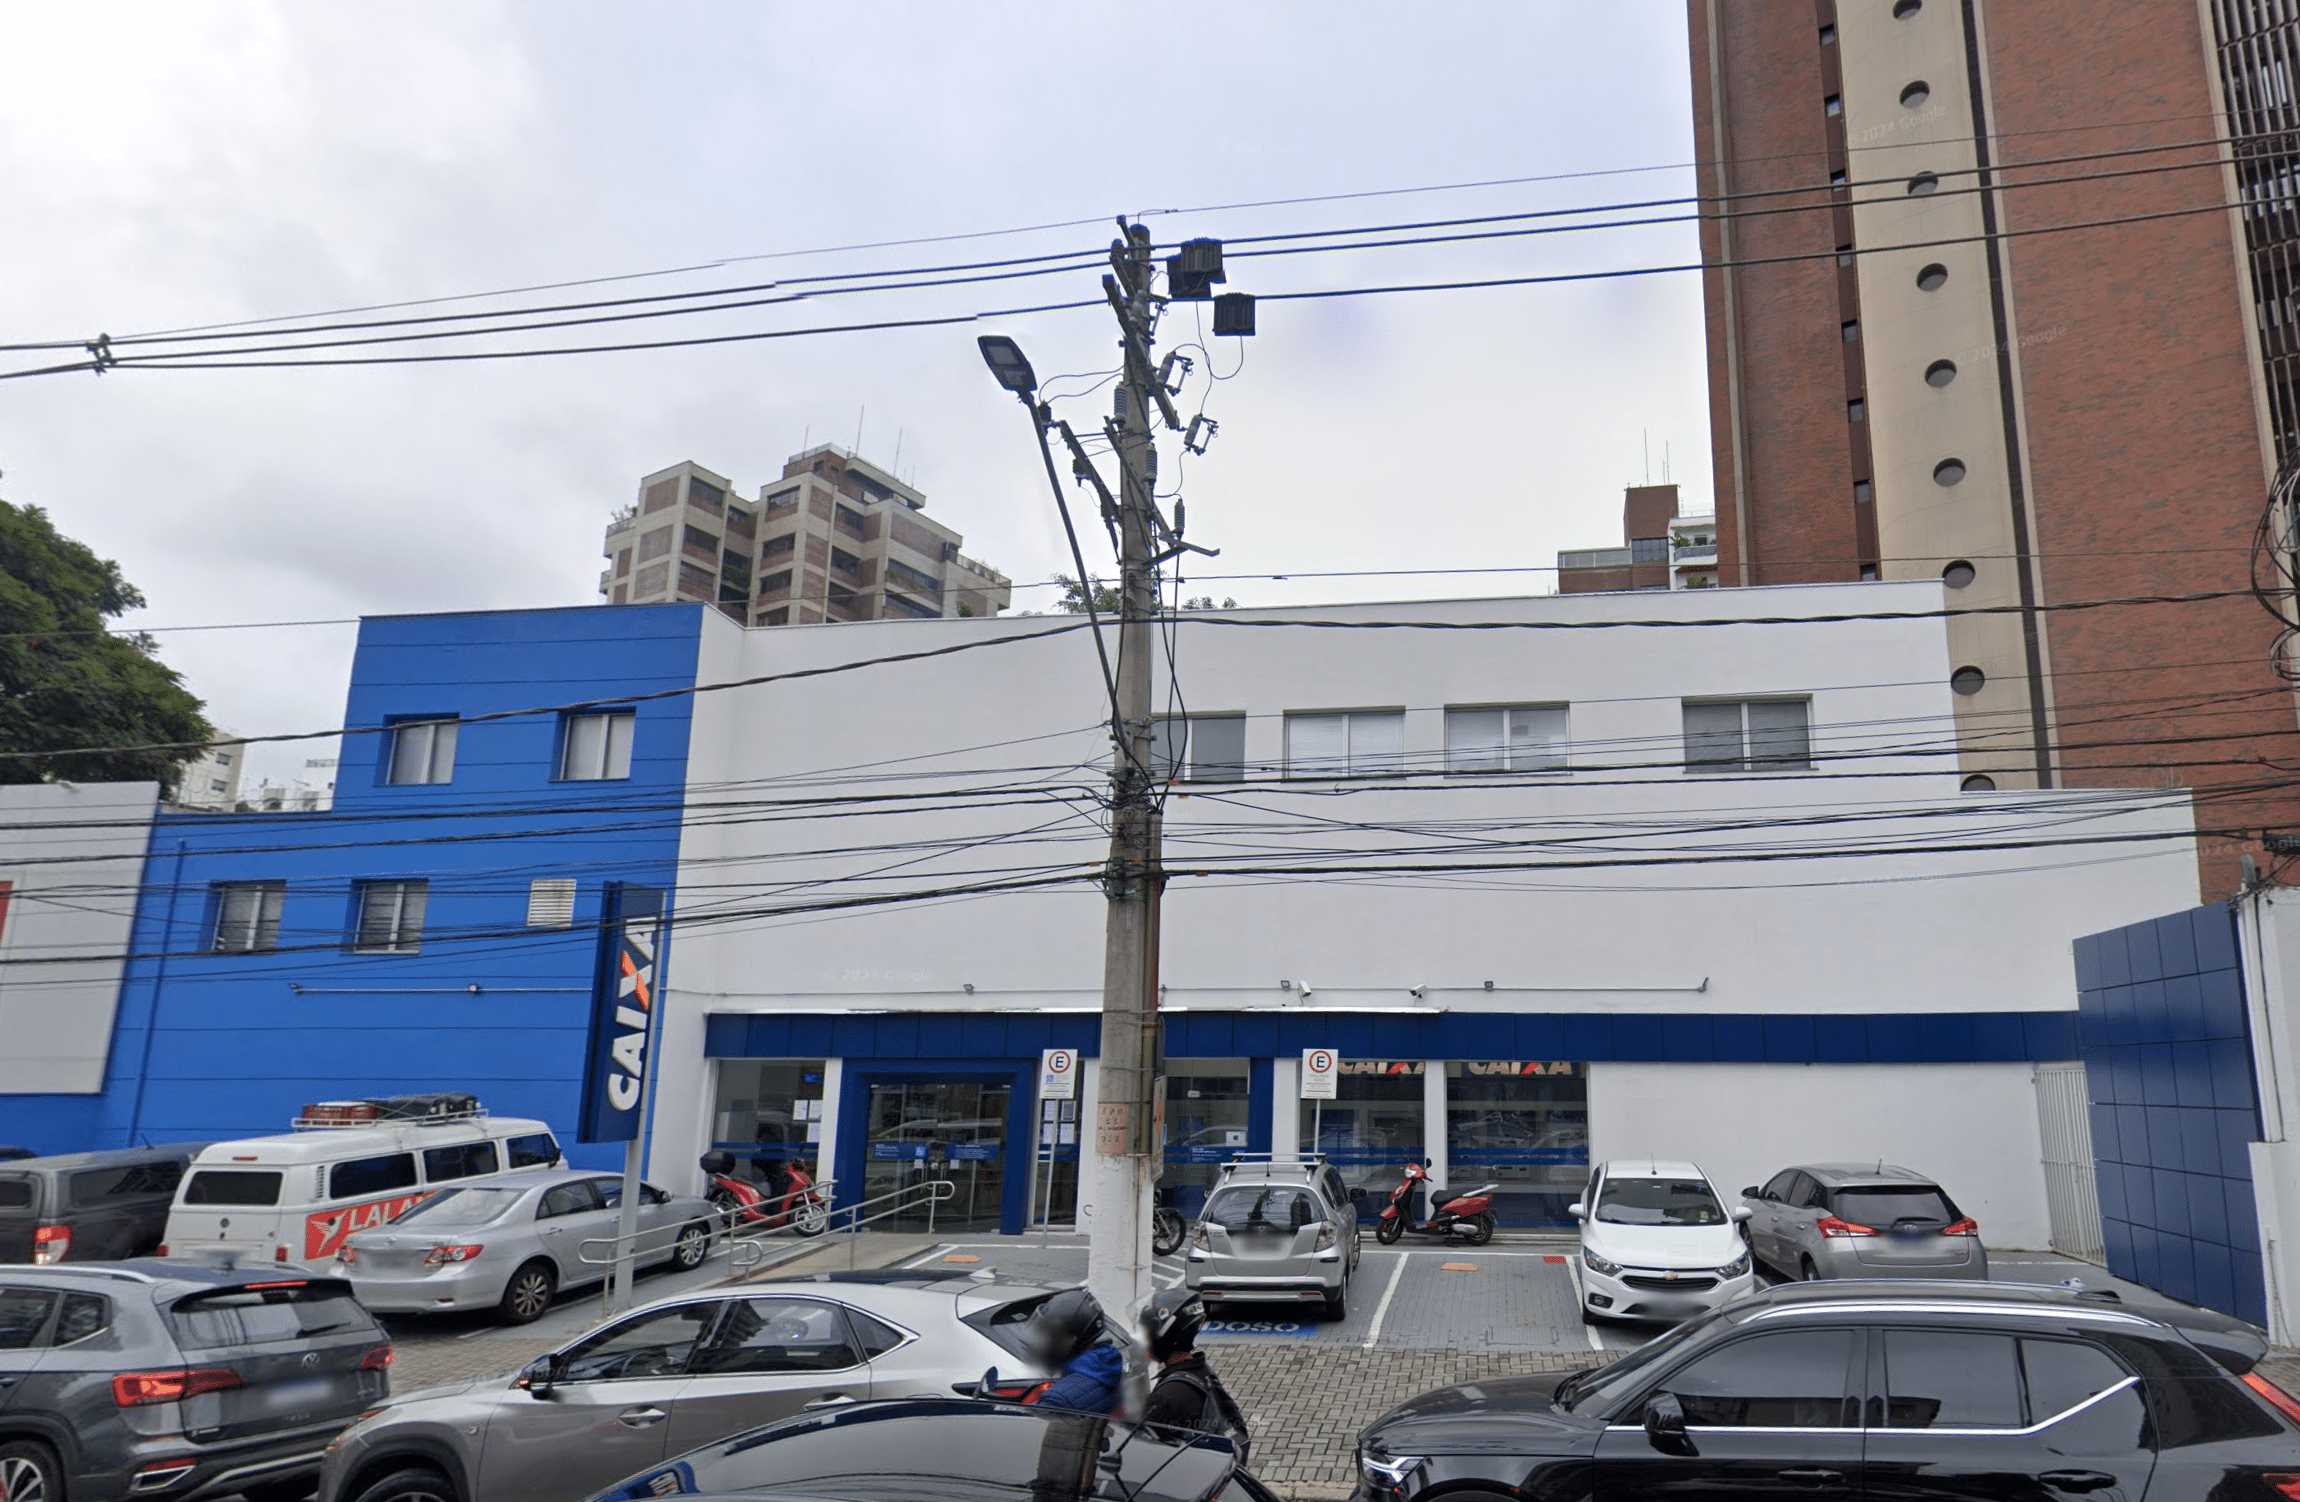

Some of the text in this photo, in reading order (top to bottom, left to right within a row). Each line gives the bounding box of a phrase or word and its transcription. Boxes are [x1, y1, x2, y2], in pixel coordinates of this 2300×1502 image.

[608, 916, 657, 1112] CAIXA
[1055, 1056, 1064, 1068] E
[1316, 1056, 1325, 1068] E
[1468, 1061, 1573, 1075] CAIXA
[347, 1197, 422, 1232] LALA
[1200, 1320, 1300, 1332] DOSO
